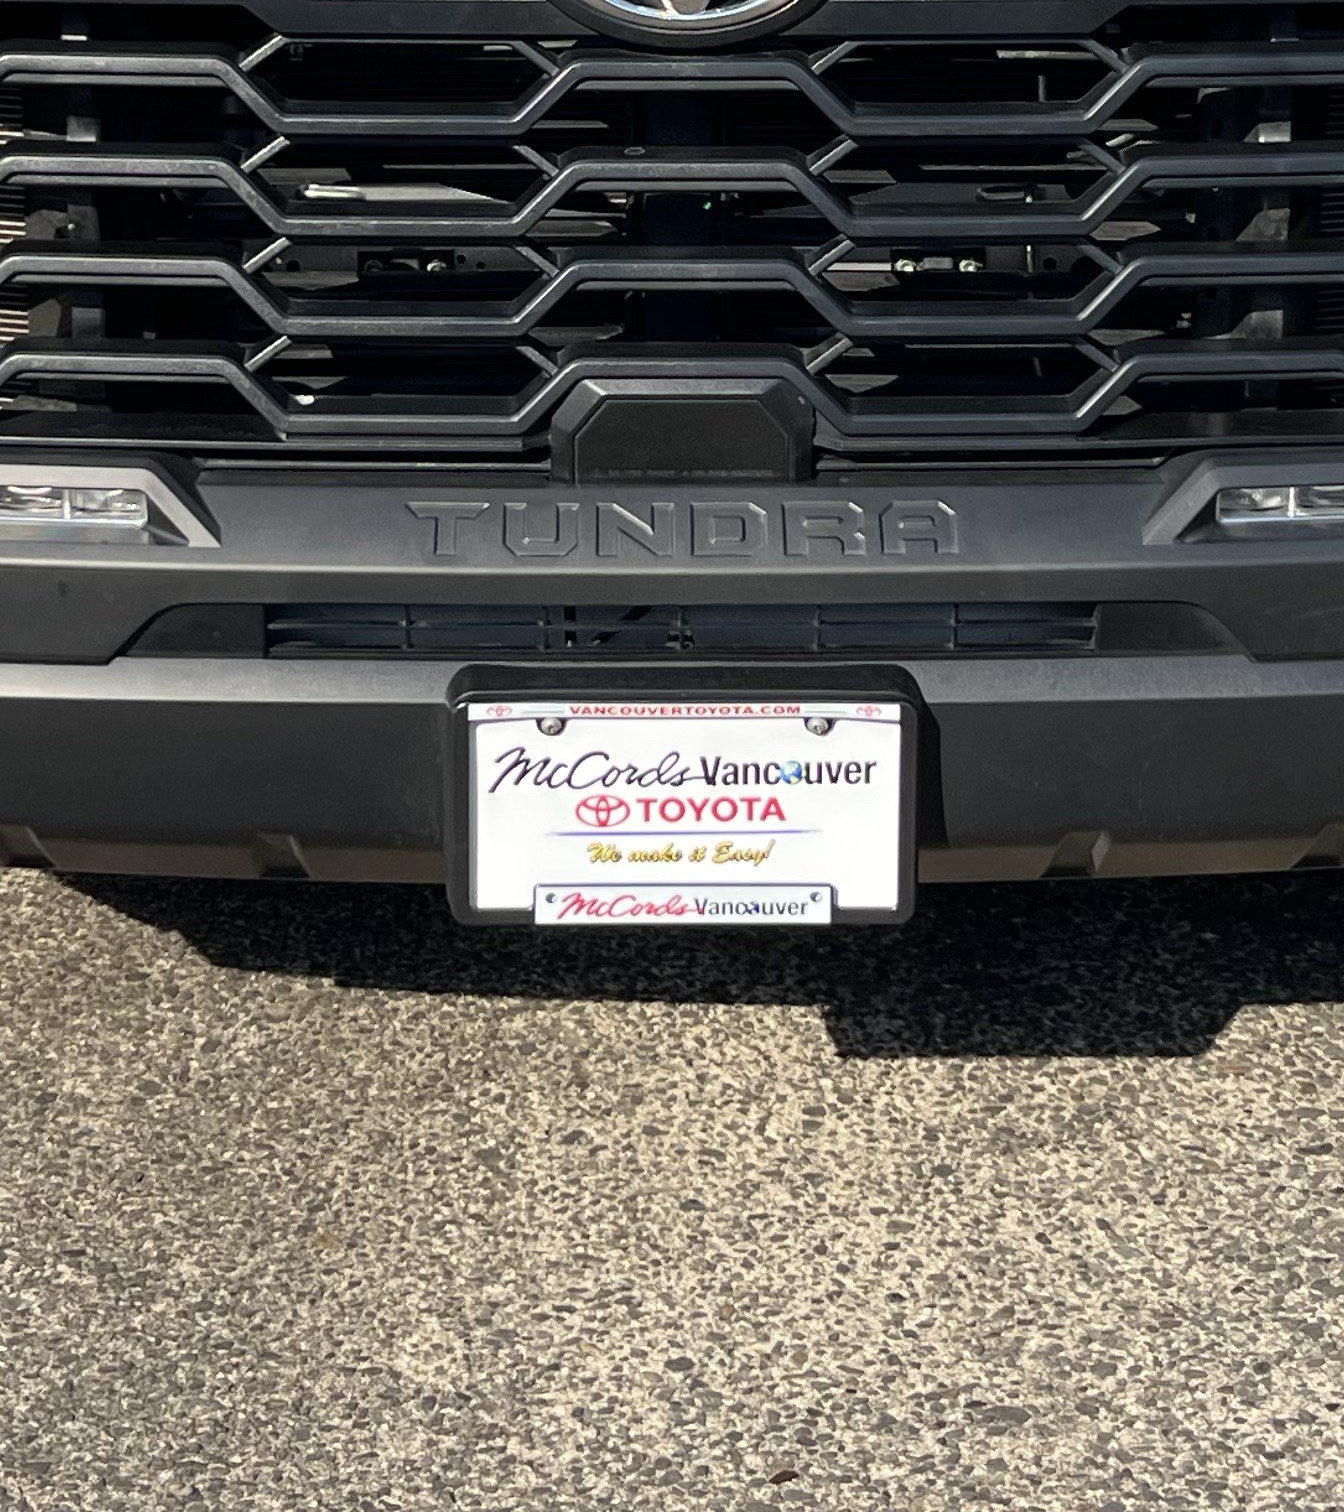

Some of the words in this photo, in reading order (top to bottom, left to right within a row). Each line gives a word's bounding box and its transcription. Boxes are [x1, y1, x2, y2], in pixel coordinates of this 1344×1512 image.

[406, 500, 958, 556] TUNDRA
[569, 705, 801, 716] VANCOUVERTOYOTA.COM
[636, 796, 787, 822] TOYOTA
[587, 842, 622, 864] We
[628, 842, 683, 863] make
[688, 844, 707, 863] it
[712, 839, 776, 867] Easy!
